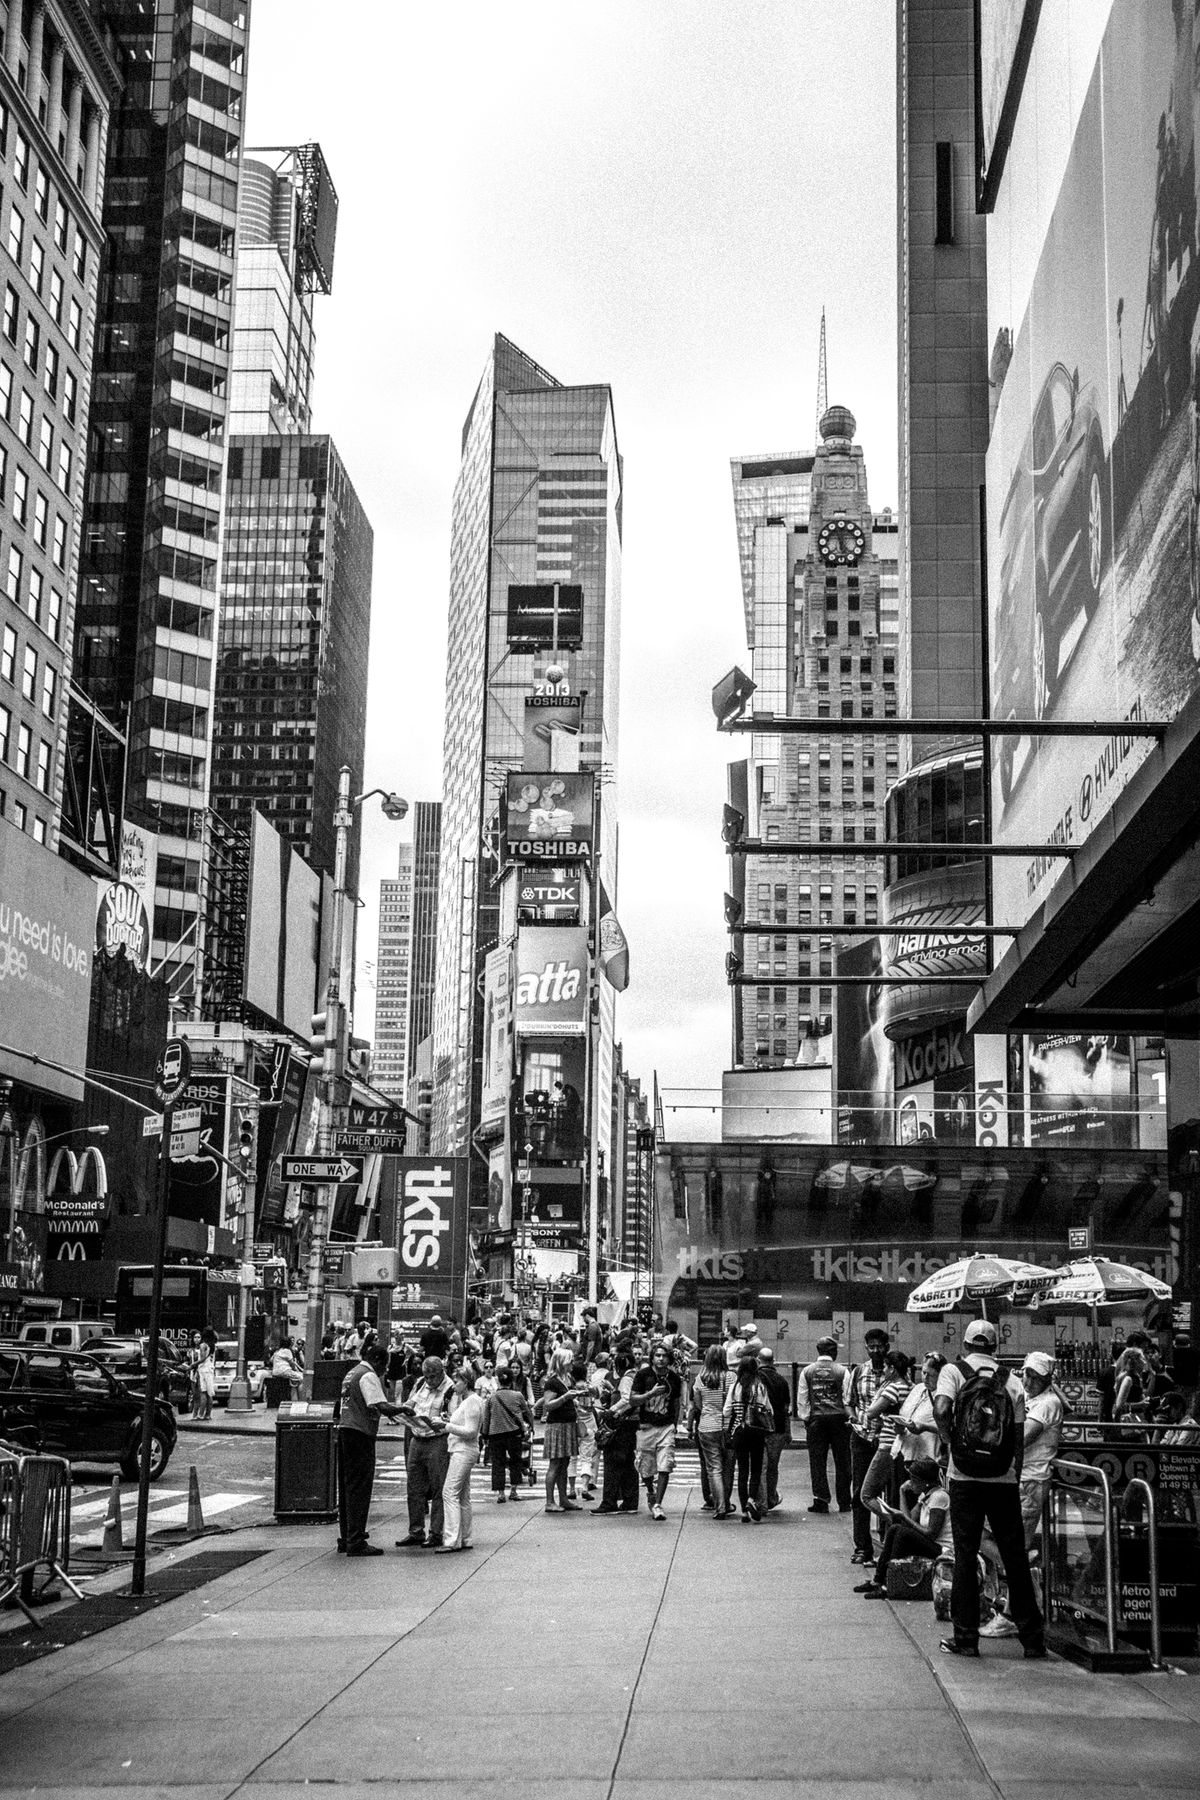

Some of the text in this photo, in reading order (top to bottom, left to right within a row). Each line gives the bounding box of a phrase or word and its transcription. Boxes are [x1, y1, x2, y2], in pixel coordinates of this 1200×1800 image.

[535, 684, 570, 696] 2013
[527, 697, 579, 706] TOSHIBA
[507, 841, 590, 856] TOSHIBA
[534, 887, 575, 900] TDK
[106, 884, 144, 935] SOUL
[13, 911, 50, 955] need
[51, 924, 60, 962] is
[910, 949, 947, 963] driving
[896, 1029, 965, 1088] Kodak
[352, 1109, 404, 1126] W 47 ST
[337, 1134, 404, 1148] FATHER DUFFY
[293, 1164, 352, 1176] ONE WAY
[43, 1200, 105, 1210] McDonald's
[402, 1165, 454, 1268] tkts
[676, 1245, 744, 1280] tkts
[913, 1287, 961, 1304] SABRETT
[779, 1319, 789, 1332] 2
[835, 1320, 845, 1334] 3
[891, 1321, 900, 1334] 4
[946, 1322, 956, 1336] 5
[1002, 1323, 1012, 1338] 6
[1058, 1325, 1067, 1338] 7
[1115, 1326, 1124, 1340] 8
[1159, 1464, 1188, 1473] Uptown
[1159, 1473, 1189, 1481] Queens
[1169, 1481, 1180, 1490] 49
[1181, 1481, 1191, 1489] St
[1124, 1599, 1153, 1610] agen
